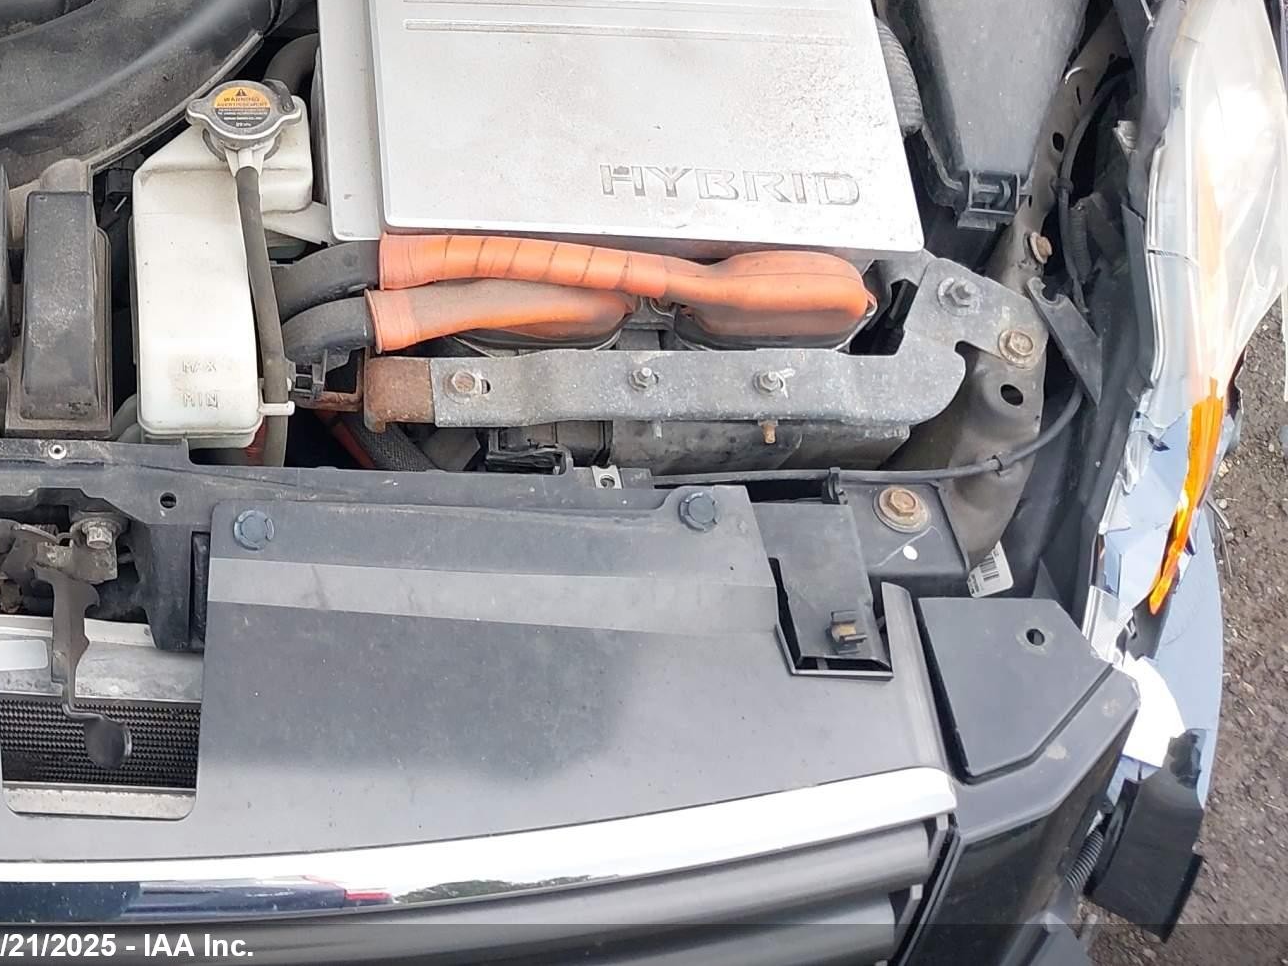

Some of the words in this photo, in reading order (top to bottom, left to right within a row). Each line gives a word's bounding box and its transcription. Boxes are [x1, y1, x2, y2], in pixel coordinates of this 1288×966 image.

[599, 164, 860, 206] HYBRID
[182, 360, 217, 374] MAX
[183, 393, 219, 408] MIN
